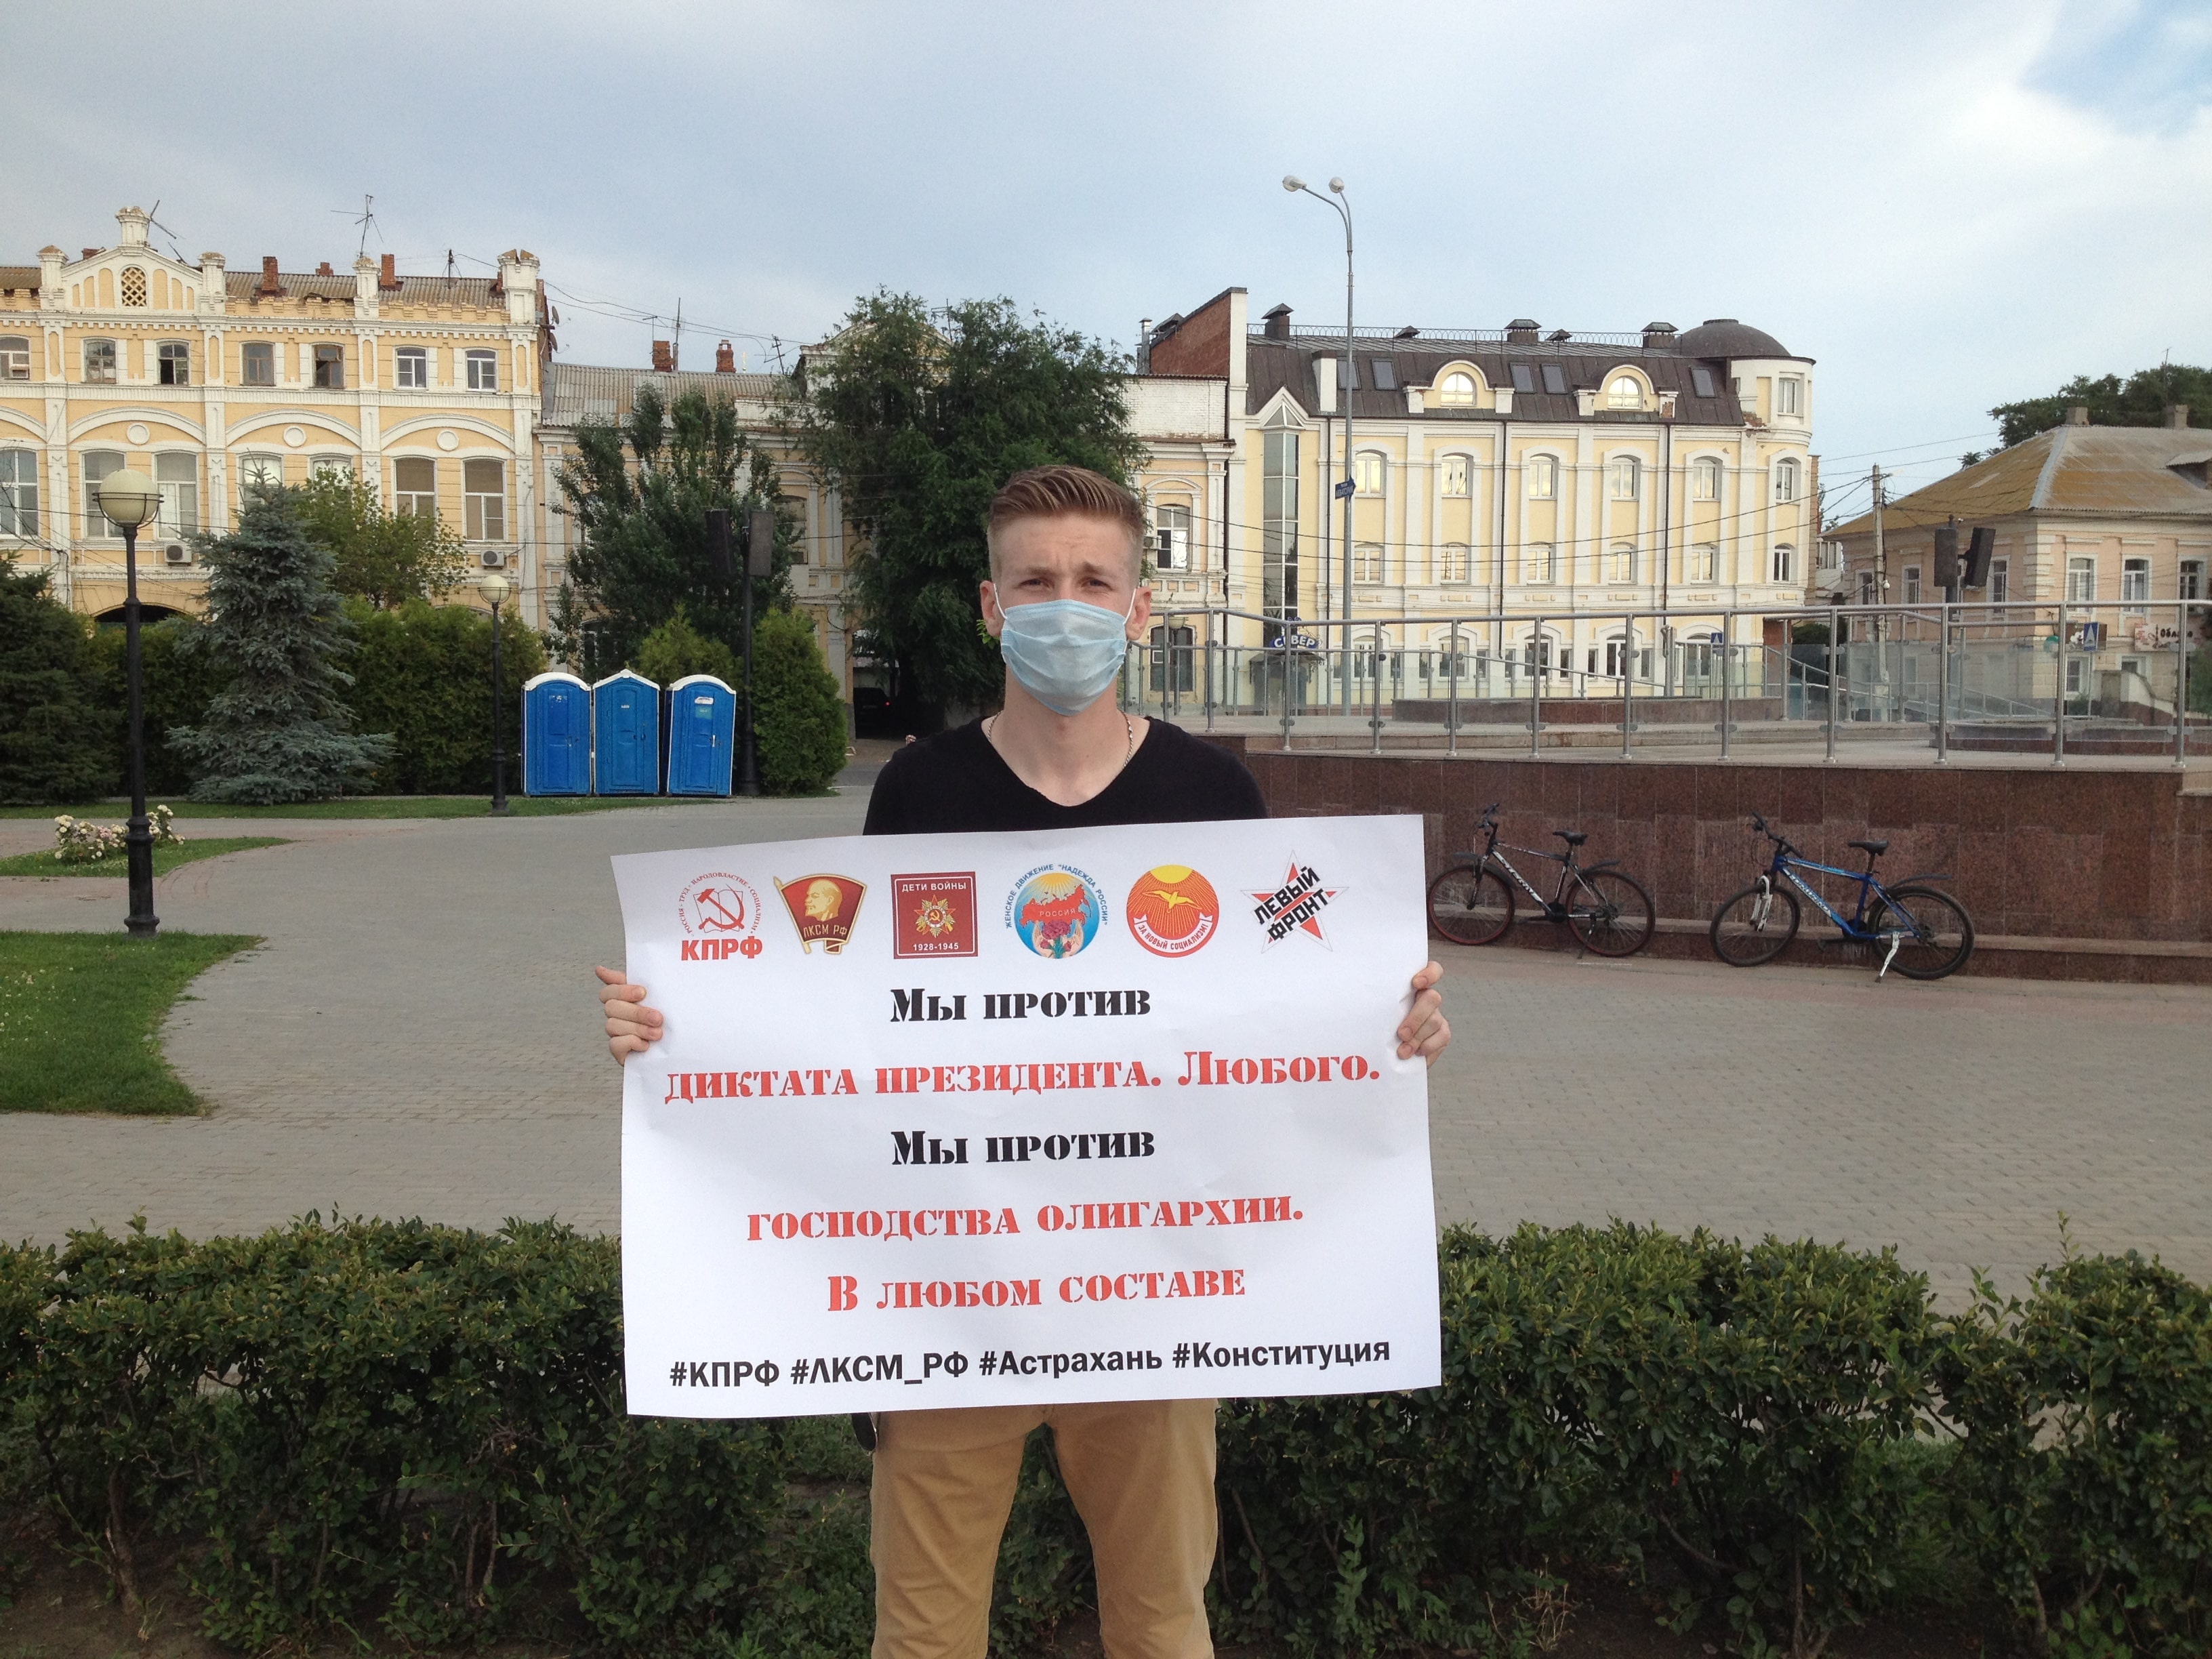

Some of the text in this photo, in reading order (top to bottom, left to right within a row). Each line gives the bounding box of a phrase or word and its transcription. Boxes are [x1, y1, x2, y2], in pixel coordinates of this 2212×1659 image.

[679, 887, 691, 902] ТРУД
[691, 872, 748, 886] НАРОДОВЛАСТИЕ
[750, 888, 761, 930] СОЦИАЛИЗМ
[902, 882, 966, 892] ДЕТИ ВОЙНЫ
[1005, 890, 1017, 929] ЖЕНСКОЕ
[1015, 864, 1054, 889] ДВИЖЕНИЕ
[1254, 866, 1320, 925] ЛЕВЫЙ
[1040, 908, 1076, 917] РОССИЯ
[1267, 888, 1328, 941] ФРОНТ
[803, 924, 847, 938] ЛКСМ РФ
[1139, 923, 1208, 950] ЗА НОВЫЙ СОЦИАЛИЗМ!
[681, 936, 762, 960] КПРФ
[913, 943, 959, 951] 1928-1945
[827, 1275, 858, 1311] В
[670, 1340, 1391, 1387] #КПРФ #ЛКСМ_РФ #Астрахань #Конституция
